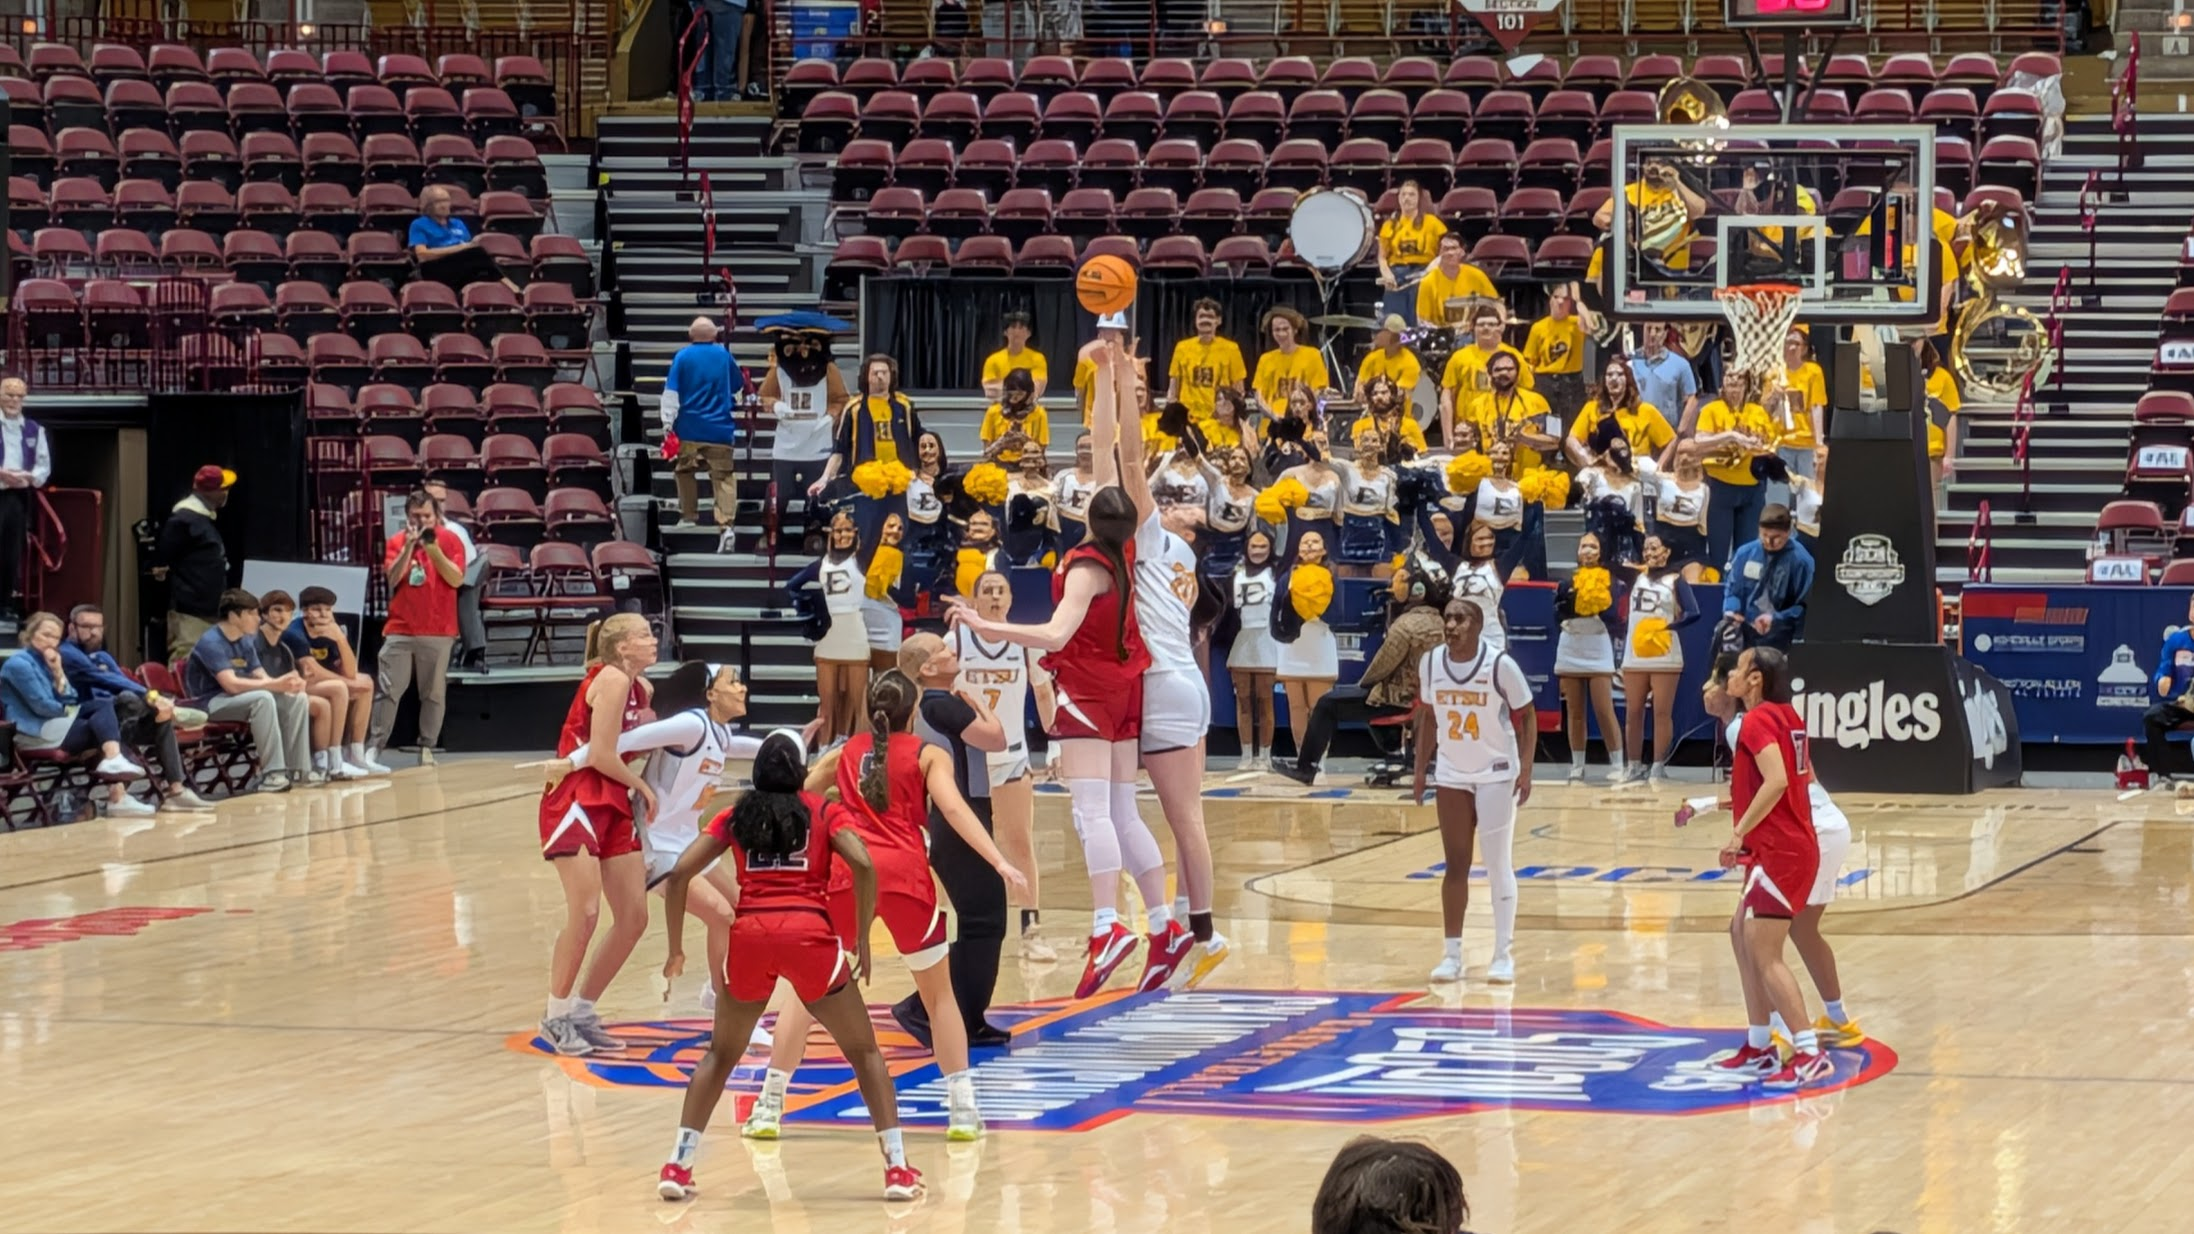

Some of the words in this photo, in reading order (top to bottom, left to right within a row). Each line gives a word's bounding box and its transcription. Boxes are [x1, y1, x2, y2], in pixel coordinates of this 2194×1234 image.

[1496, 13, 1525, 30] 101
[826, 569, 852, 595] E
[1239, 582, 1270, 606] E
[1633, 587, 1662, 613] E
[982, 688, 1001, 711] 7
[1447, 710, 1480, 741] 24
[1790, 677, 1942, 750] ingles
